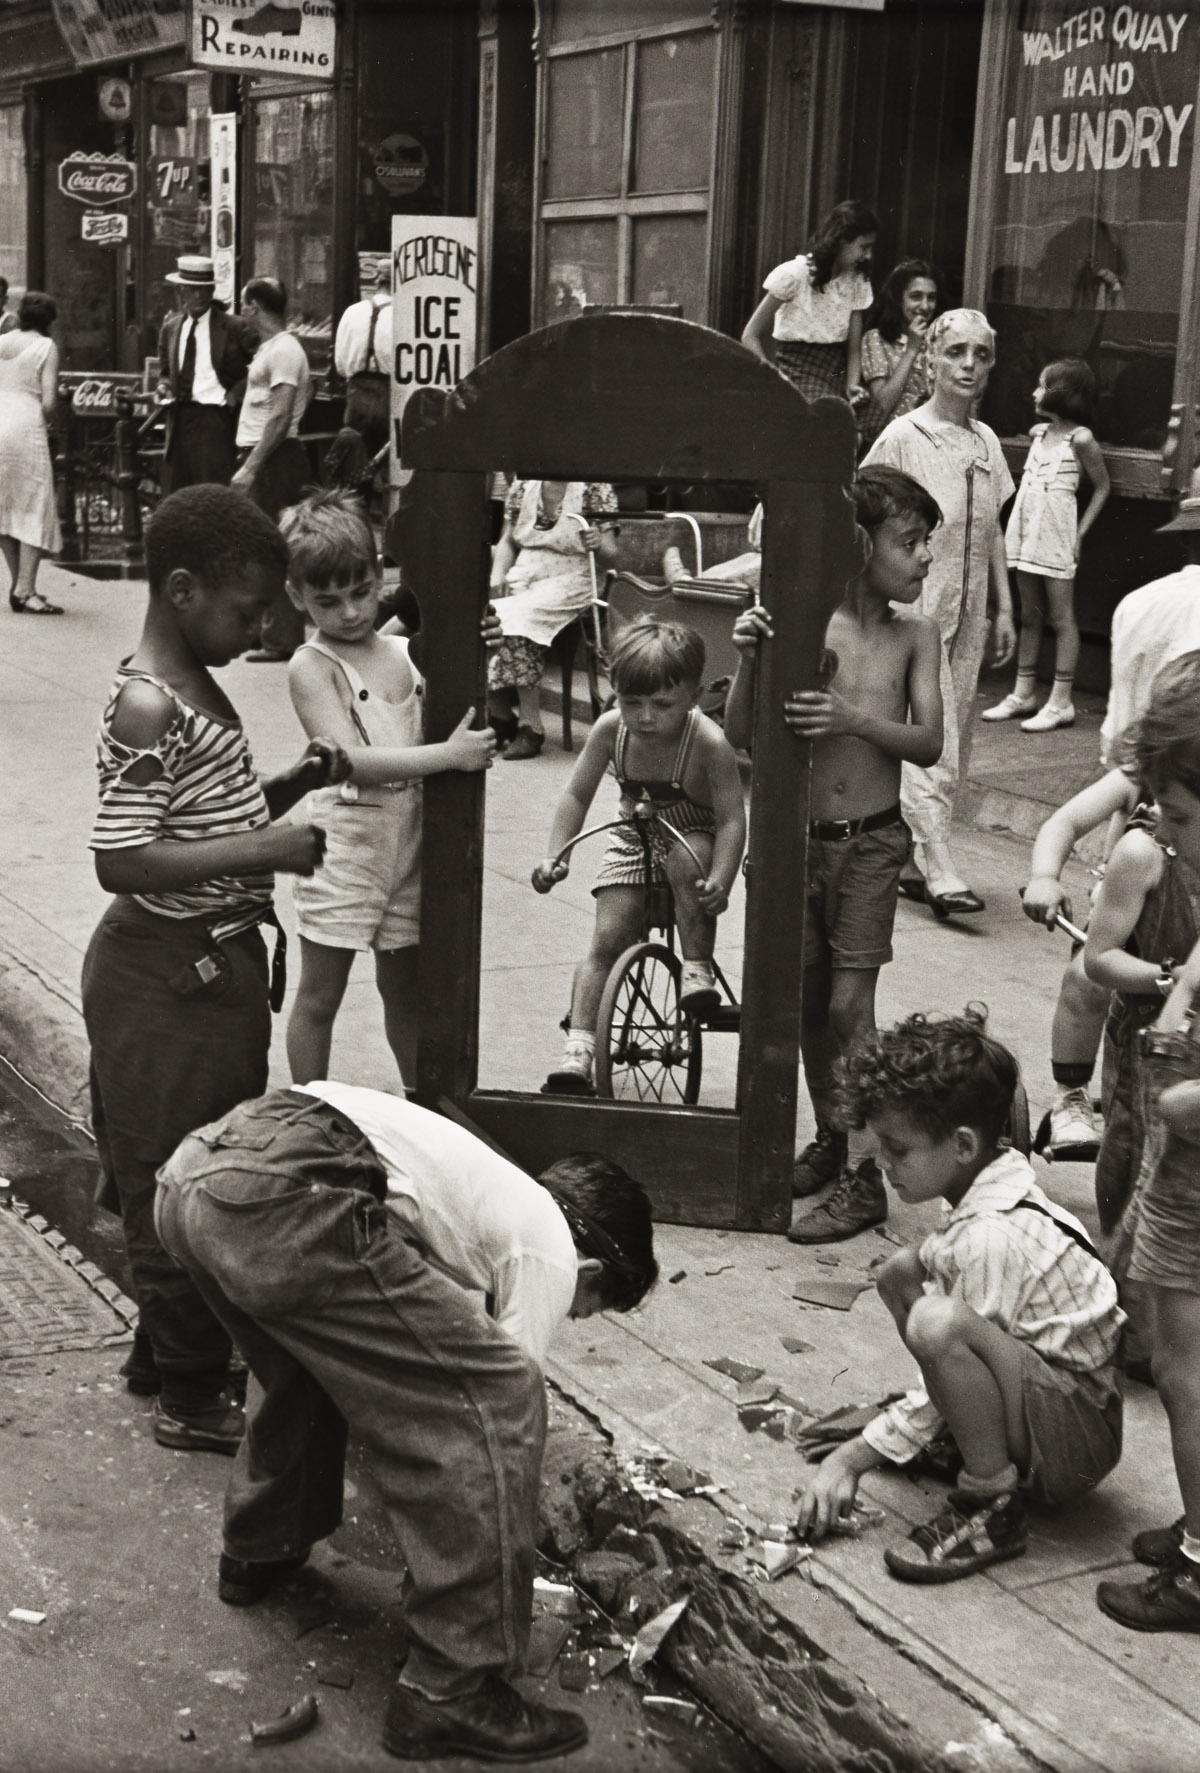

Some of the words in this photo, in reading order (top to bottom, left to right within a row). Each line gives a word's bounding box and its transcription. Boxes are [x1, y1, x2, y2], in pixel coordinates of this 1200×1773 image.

[201, 14, 329, 66] REPAIRING
[1023, 6, 1106, 66] WALTER
[1112, 5, 1189, 53] QUAY
[1062, 61, 1134, 98] HAND
[1005, 104, 1194, 174] LAUNDRY
[393, 235, 478, 294] KEROSENE
[414, 296, 461, 339] ICE
[394, 343, 462, 386] COAL
